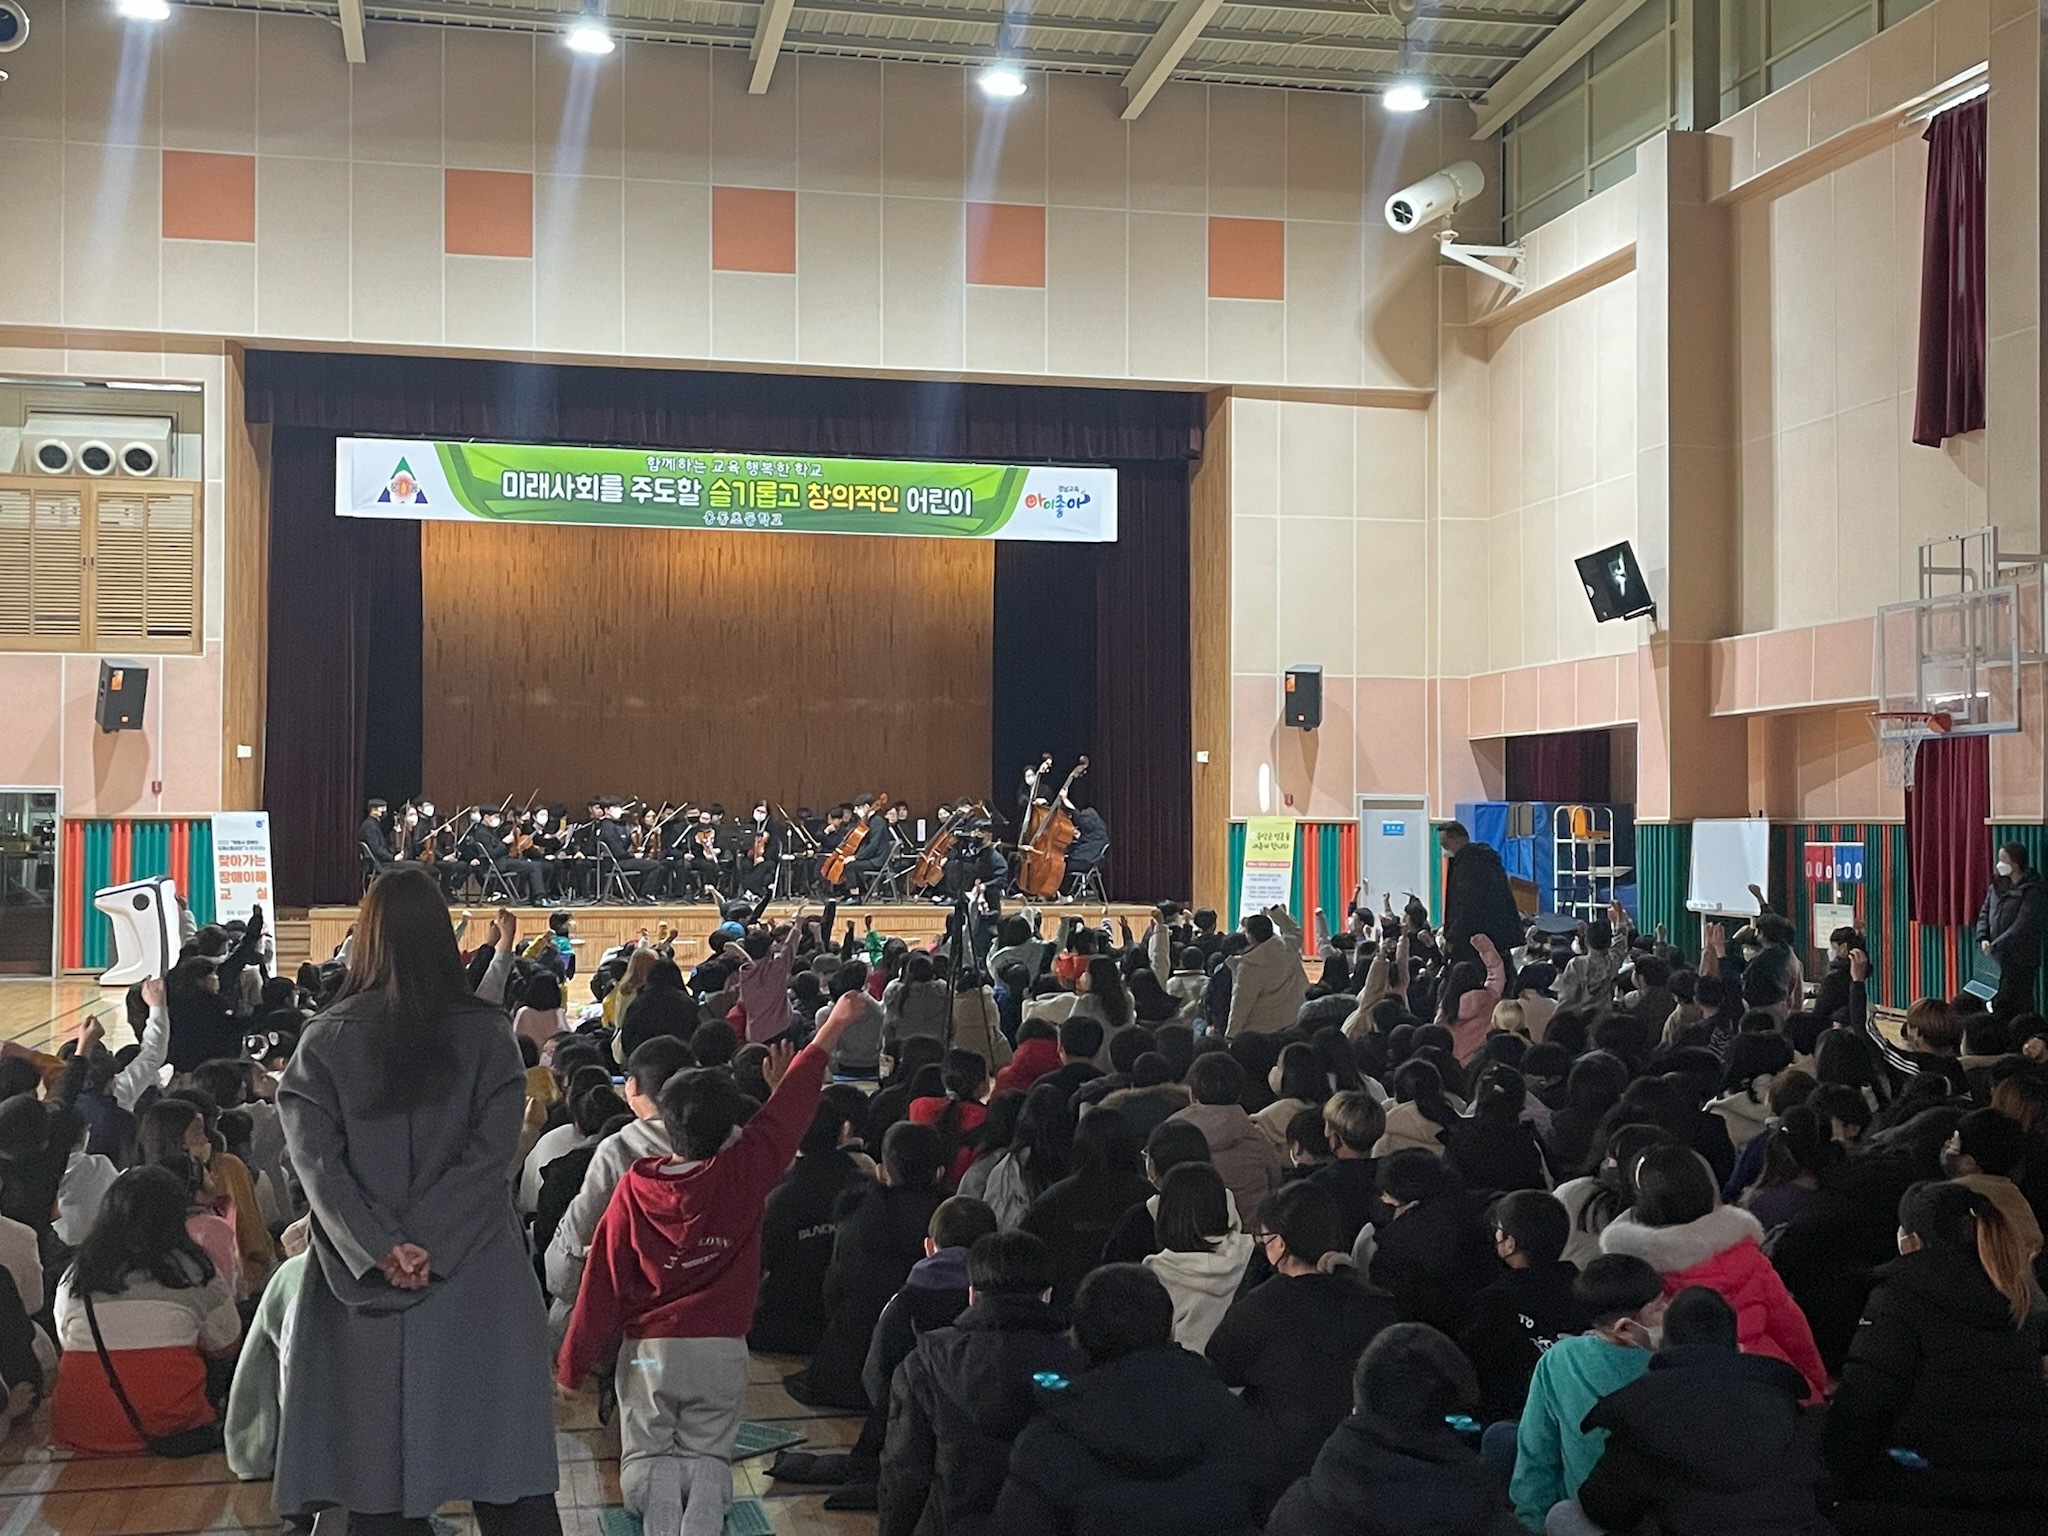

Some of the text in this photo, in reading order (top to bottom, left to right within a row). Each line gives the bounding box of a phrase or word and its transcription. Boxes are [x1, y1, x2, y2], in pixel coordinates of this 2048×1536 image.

[646, 456, 823, 478] 함께하는 교육 행복한 학교
[502, 470, 973, 516] 미래사회를 주도할 슬기롭고 창의적인 어린이
[1025, 493, 1091, 519] 아이좋아
[218, 854, 266, 867] 찾아가는
[219, 871, 267, 884] 장애이해
